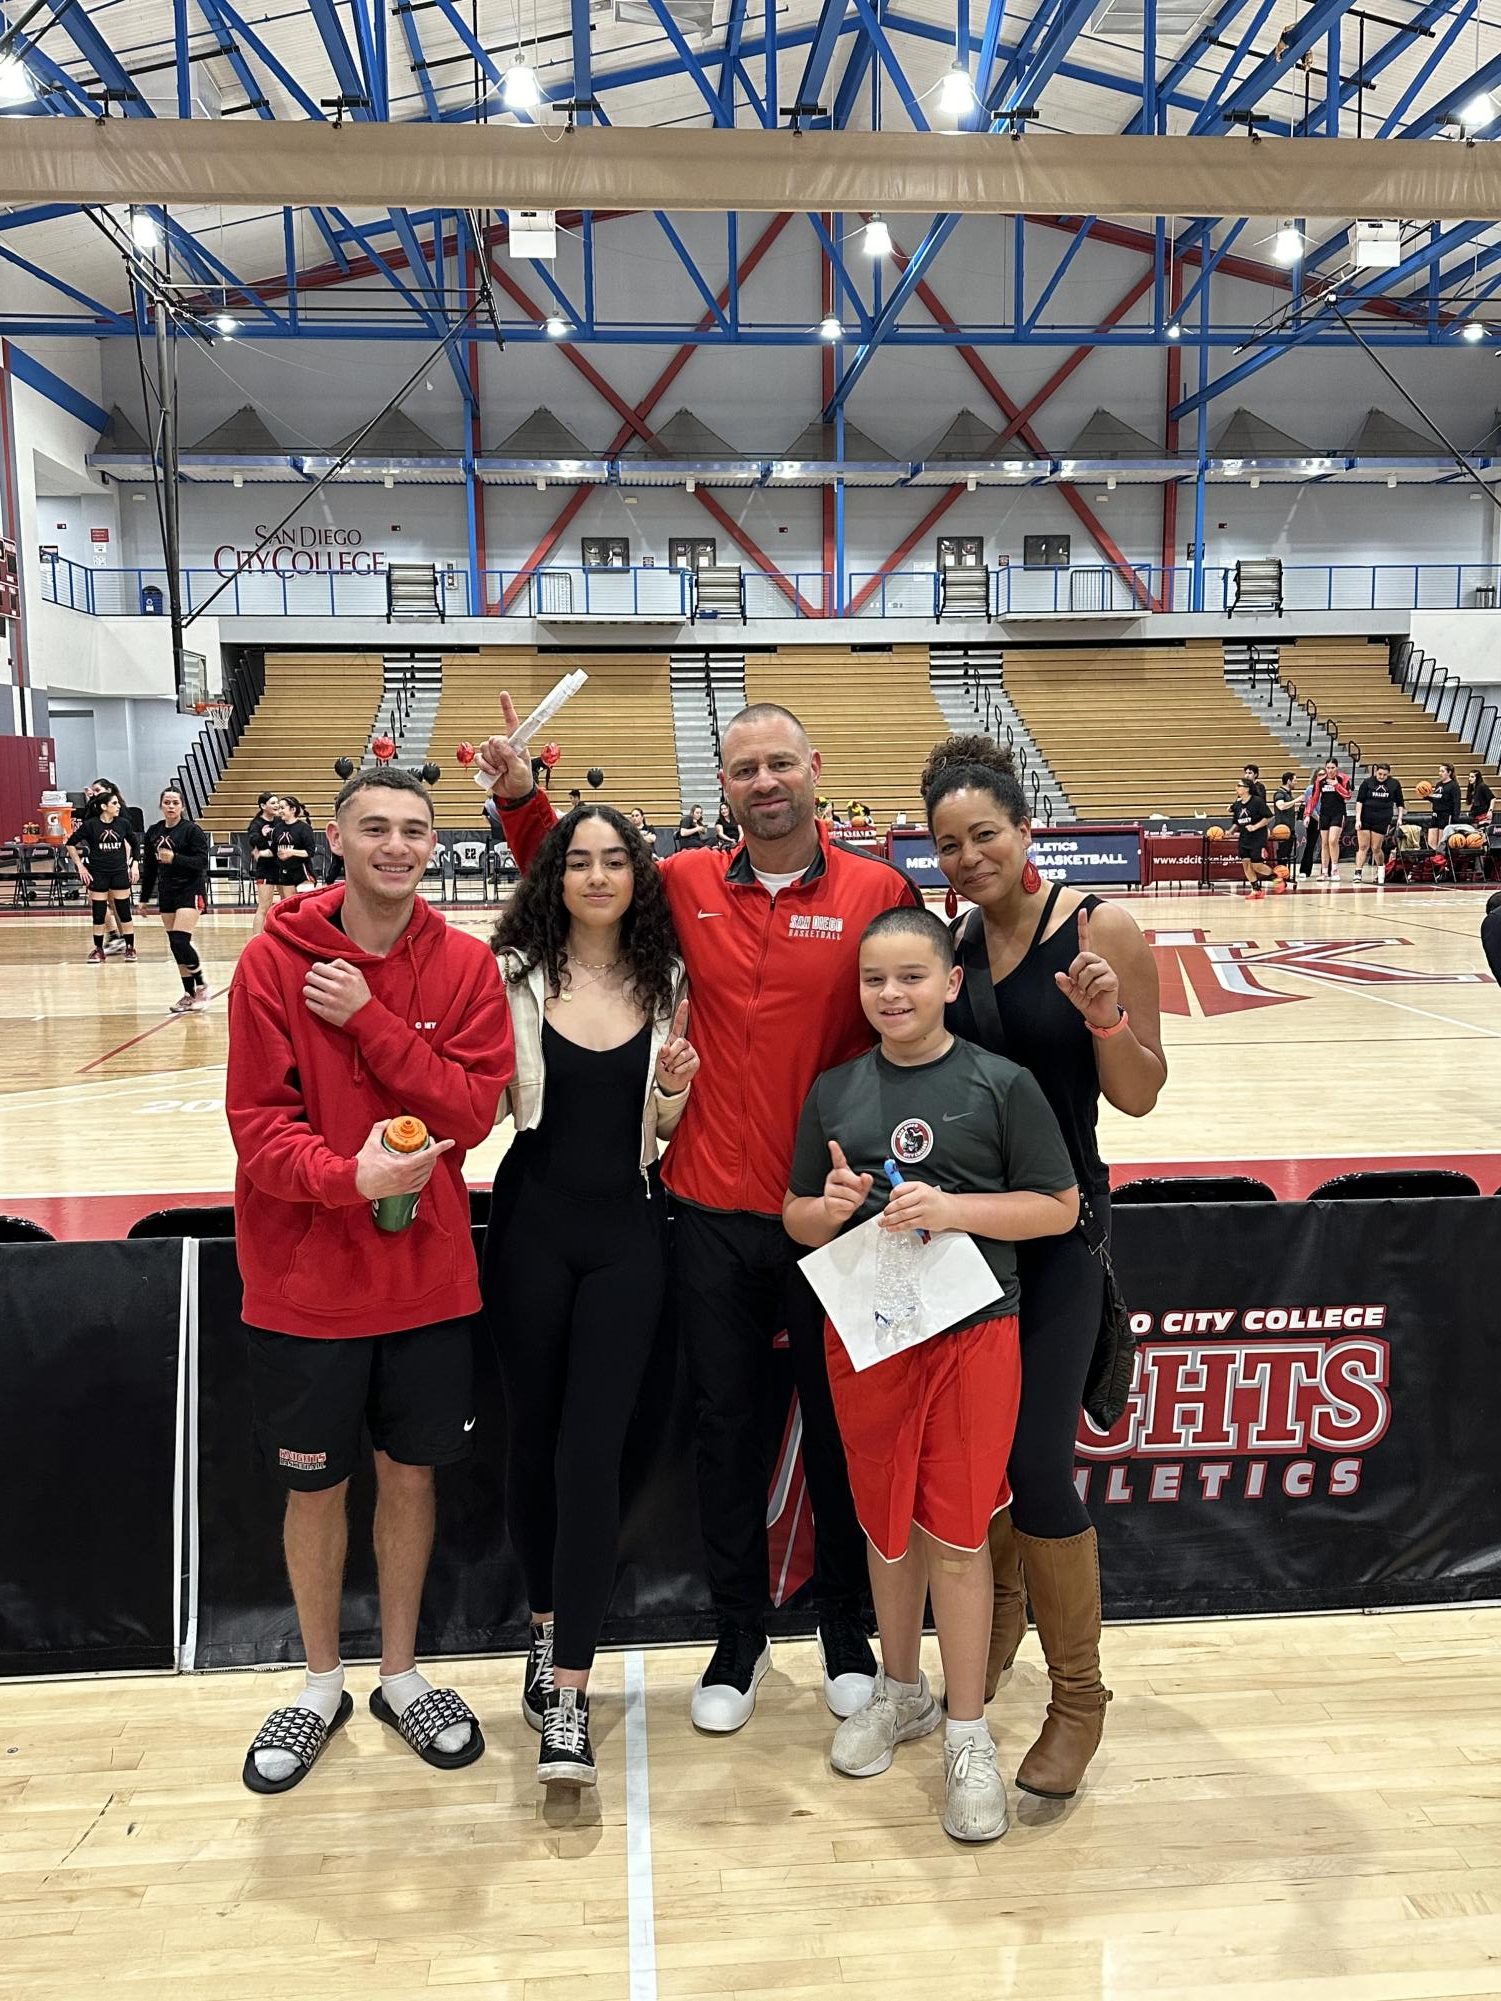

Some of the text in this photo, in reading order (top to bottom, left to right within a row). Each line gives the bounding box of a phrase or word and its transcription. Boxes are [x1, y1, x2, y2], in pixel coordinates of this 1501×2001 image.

[47, 813, 59, 825] G
[1027, 841, 1078, 852] LETICS
[1035, 854, 1128, 866] BASKETBALL
[788, 929, 841, 941] BASKETBALL
[1161, 1310, 1235, 1334] CITY
[1243, 1305, 1387, 1332] COLLEGE
[1073, 1458, 1363, 1504] LETICS
